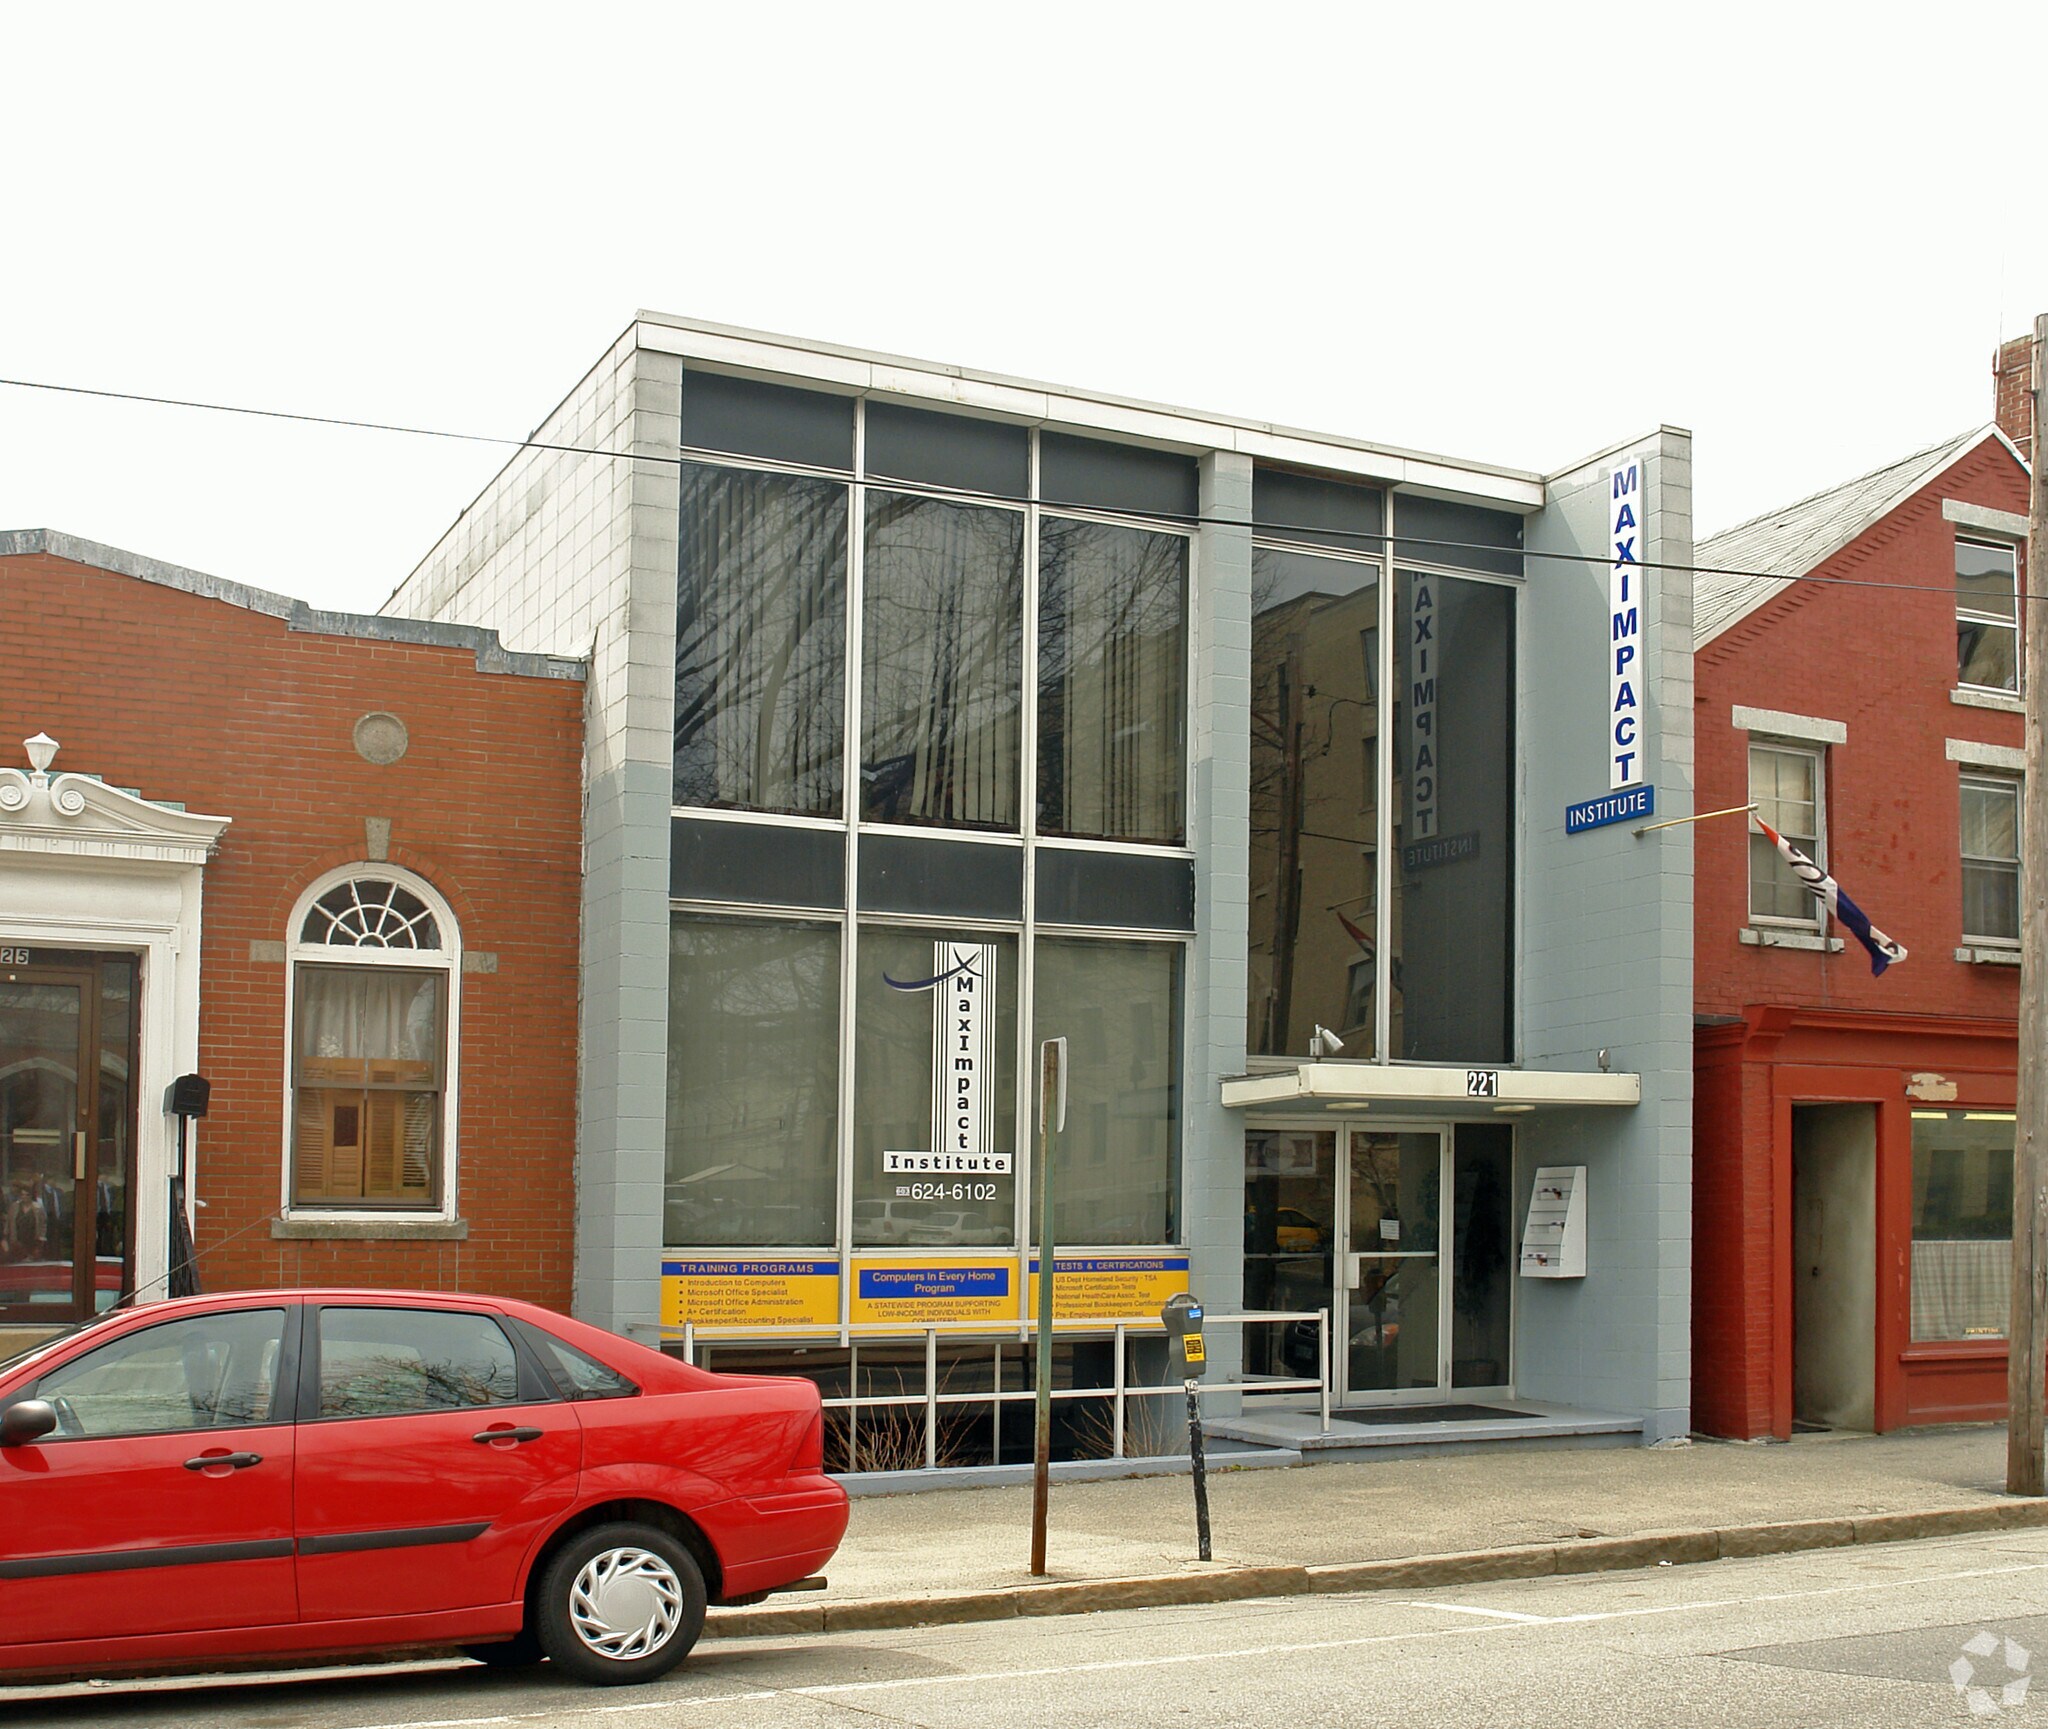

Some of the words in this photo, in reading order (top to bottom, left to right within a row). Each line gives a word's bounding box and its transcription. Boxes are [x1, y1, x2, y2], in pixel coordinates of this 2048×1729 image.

[1613, 465, 1637, 782] MAXIMPACT
[1570, 792, 1646, 827] INSTITUTE
[955, 976, 974, 1149] MaxImpact
[1468, 1071, 1497, 1096] 221
[890, 1155, 1005, 1170] Institute
[911, 1183, 996, 1200] 624-6102
[681, 1264, 738, 1273] TRAINING
[742, 1264, 814, 1273] PROGRAMS
[1056, 1262, 1083, 1270] TESTS
[1086, 1262, 1093, 1270] &
[1096, 1261, 1164, 1270] CERTIFICATIONS
[872, 1272, 925, 1283] Computers
[927, 1272, 936, 1281] In
[939, 1272, 966, 1282] Every
[968, 1272, 996, 1281] Home
[1115, 1275, 1139, 1283] Security
[743, 1279, 786, 1287] Computers
[751, 1289, 788, 1297] Specialist
[914, 1284, 955, 1294] Program
[874, 1301, 915, 1309] STATEWIDE
[955, 1300, 1001, 1308] SUPPORTING
[1056, 1301, 1093, 1309] Professional
[878, 1310, 925, 1318] LOW-INCOME
[927, 1309, 971, 1317] INDIVIDUALS
[972, 1308, 991, 1316] WITH
[777, 1316, 814, 1324] Specialist
